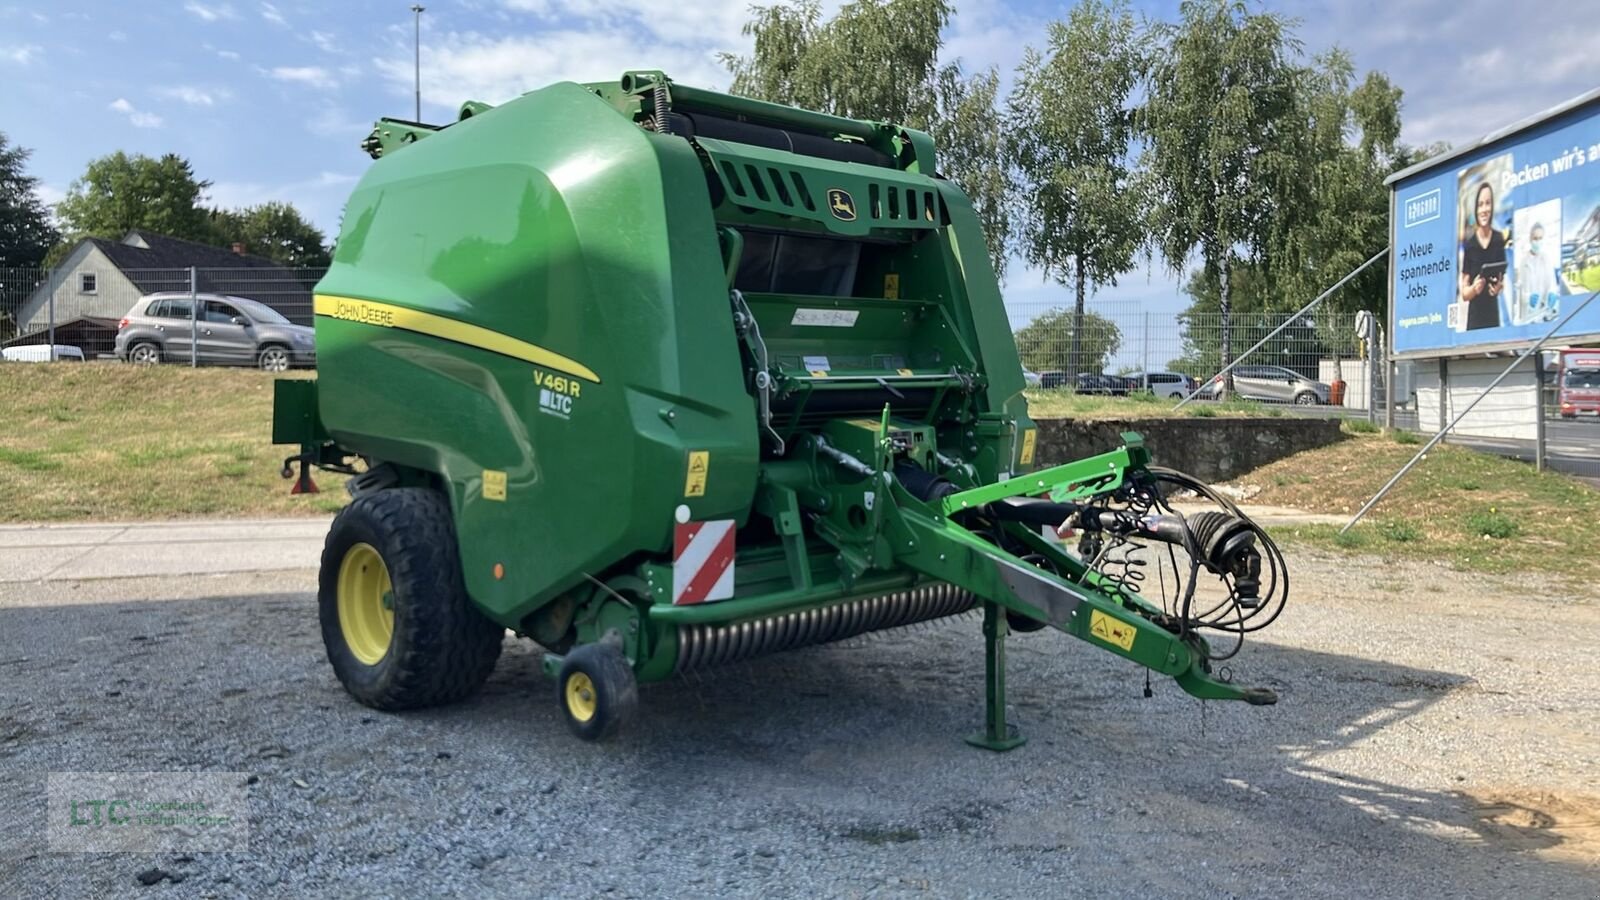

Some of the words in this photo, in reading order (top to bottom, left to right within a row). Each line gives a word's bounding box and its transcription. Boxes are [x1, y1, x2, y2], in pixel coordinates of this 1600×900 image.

[1501, 162, 1549, 192] Packen
[1552, 146, 1585, 174] wir's
[1409, 242, 1433, 260] Neue
[1400, 255, 1451, 284] spannende
[1406, 281, 1428, 300] Jobs
[334, 300, 359, 318] JOHN
[361, 304, 393, 325] DEERE
[533, 369, 544, 386] V
[544, 374, 568, 394] 461
[570, 380, 581, 398] R
[550, 391, 573, 414] LTC
